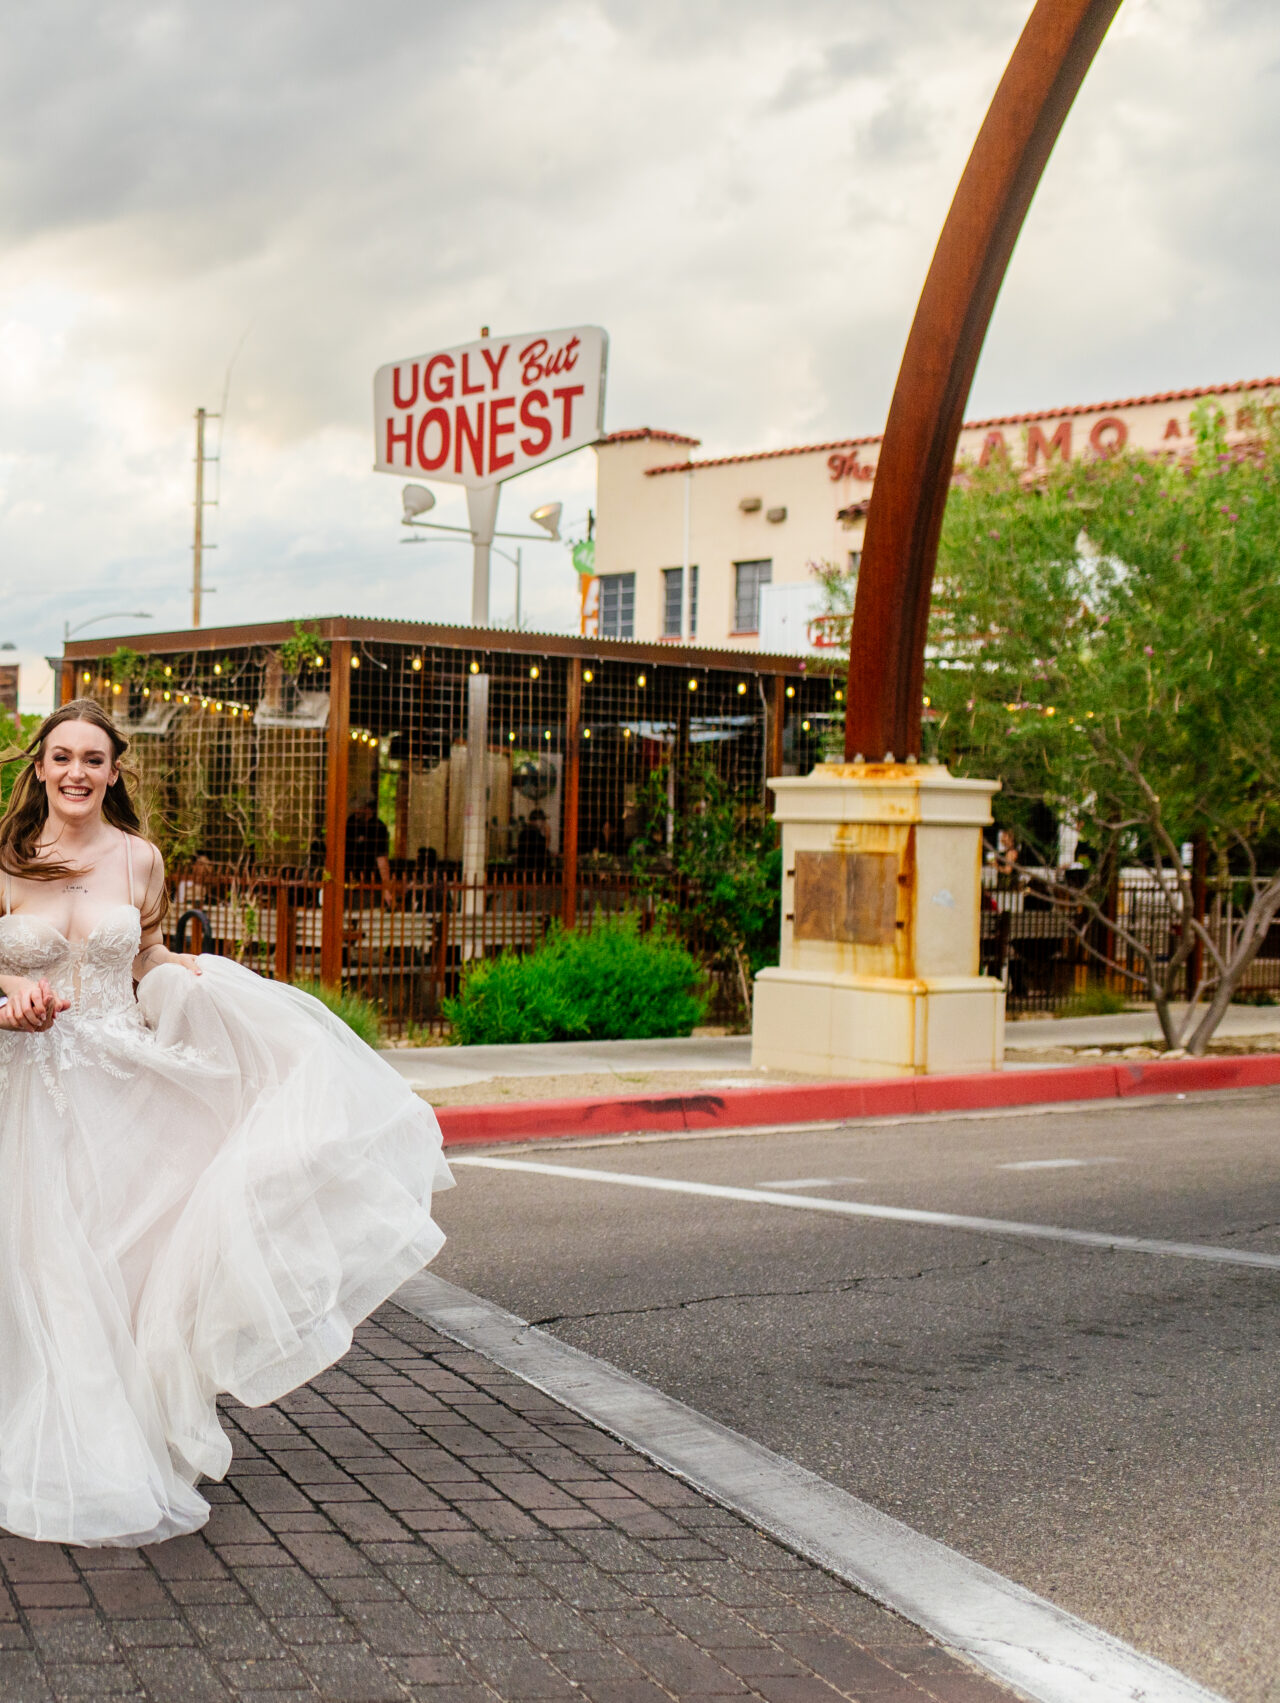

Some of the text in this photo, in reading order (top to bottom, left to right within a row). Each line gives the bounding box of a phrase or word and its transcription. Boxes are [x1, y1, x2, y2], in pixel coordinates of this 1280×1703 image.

[392, 335, 581, 411] UGLY But
[385, 384, 585, 478] HONEST
[827, 449, 875, 484] The
